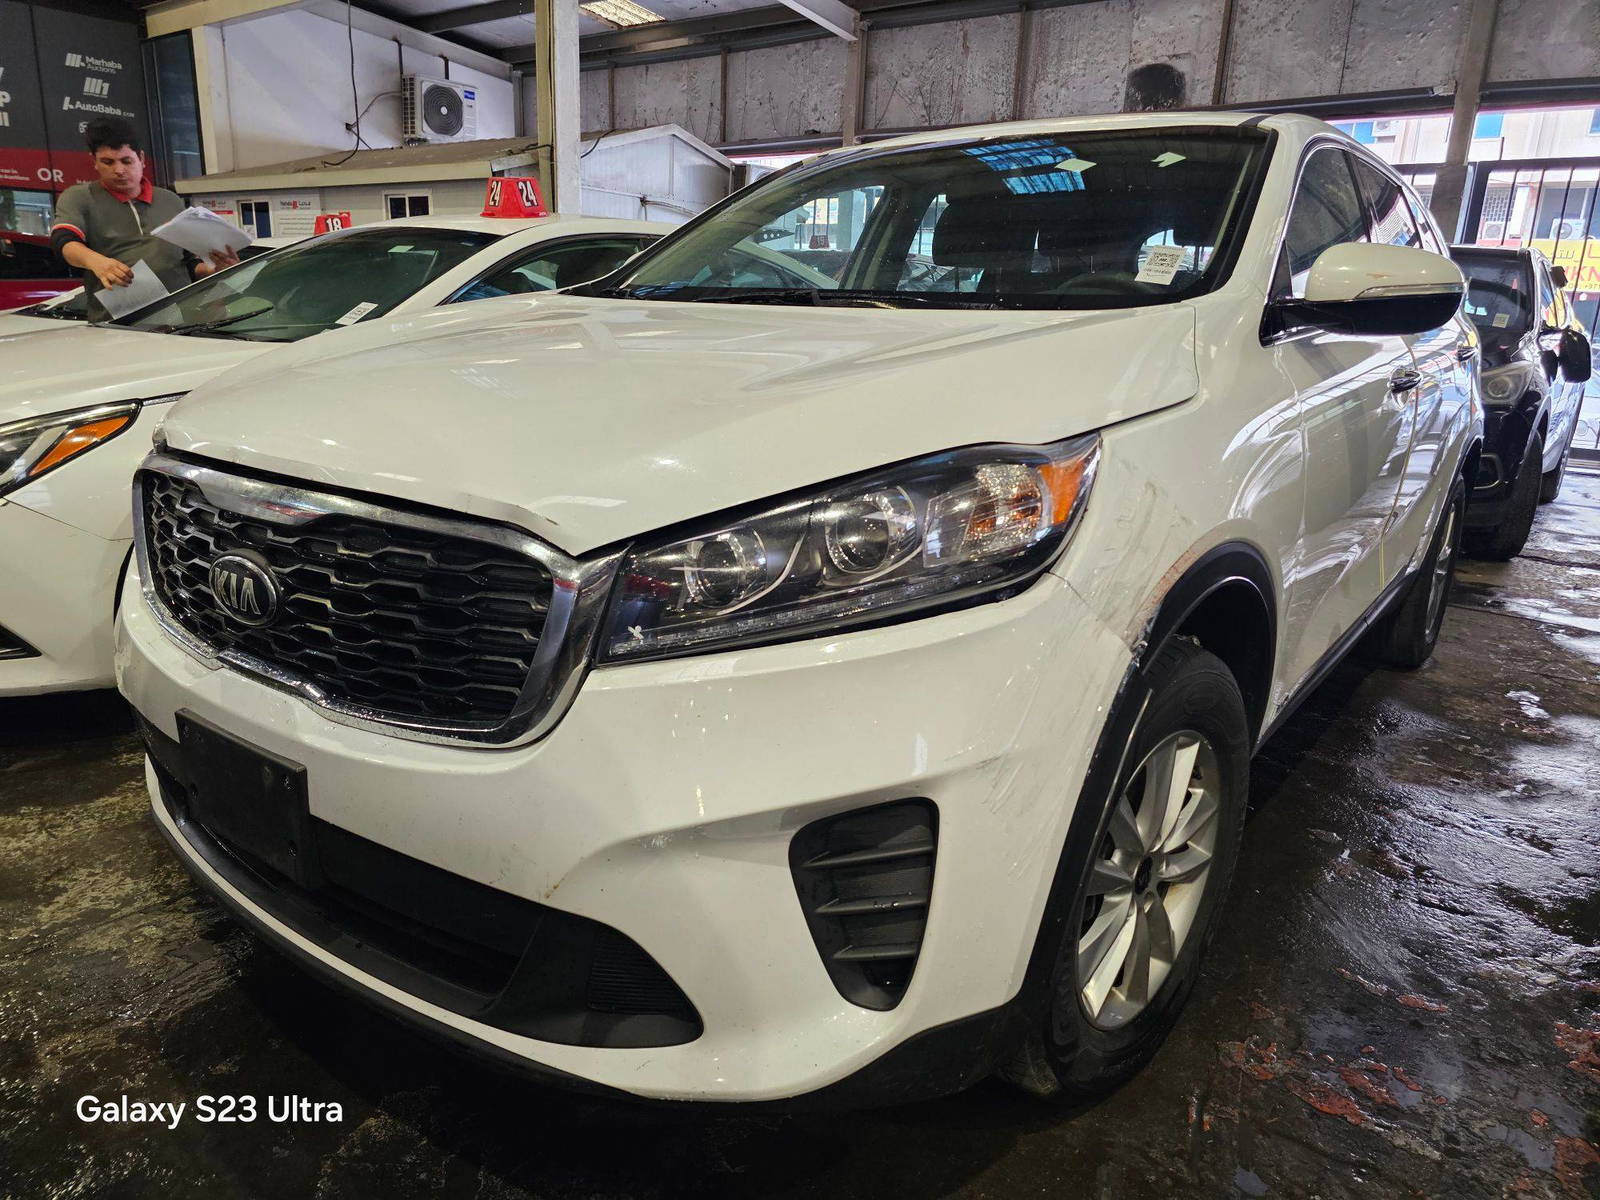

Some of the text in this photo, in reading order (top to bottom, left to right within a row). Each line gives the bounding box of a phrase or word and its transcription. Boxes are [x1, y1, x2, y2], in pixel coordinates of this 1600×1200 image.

[85, 55, 123, 70] Marhaba
[86, 64, 117, 74] Auctions
[37, 167, 64, 183] OR
[489, 180, 501, 206] 24
[518, 180, 538, 207] 24
[325, 217, 342, 232] 18
[214, 567, 262, 615] KIA
